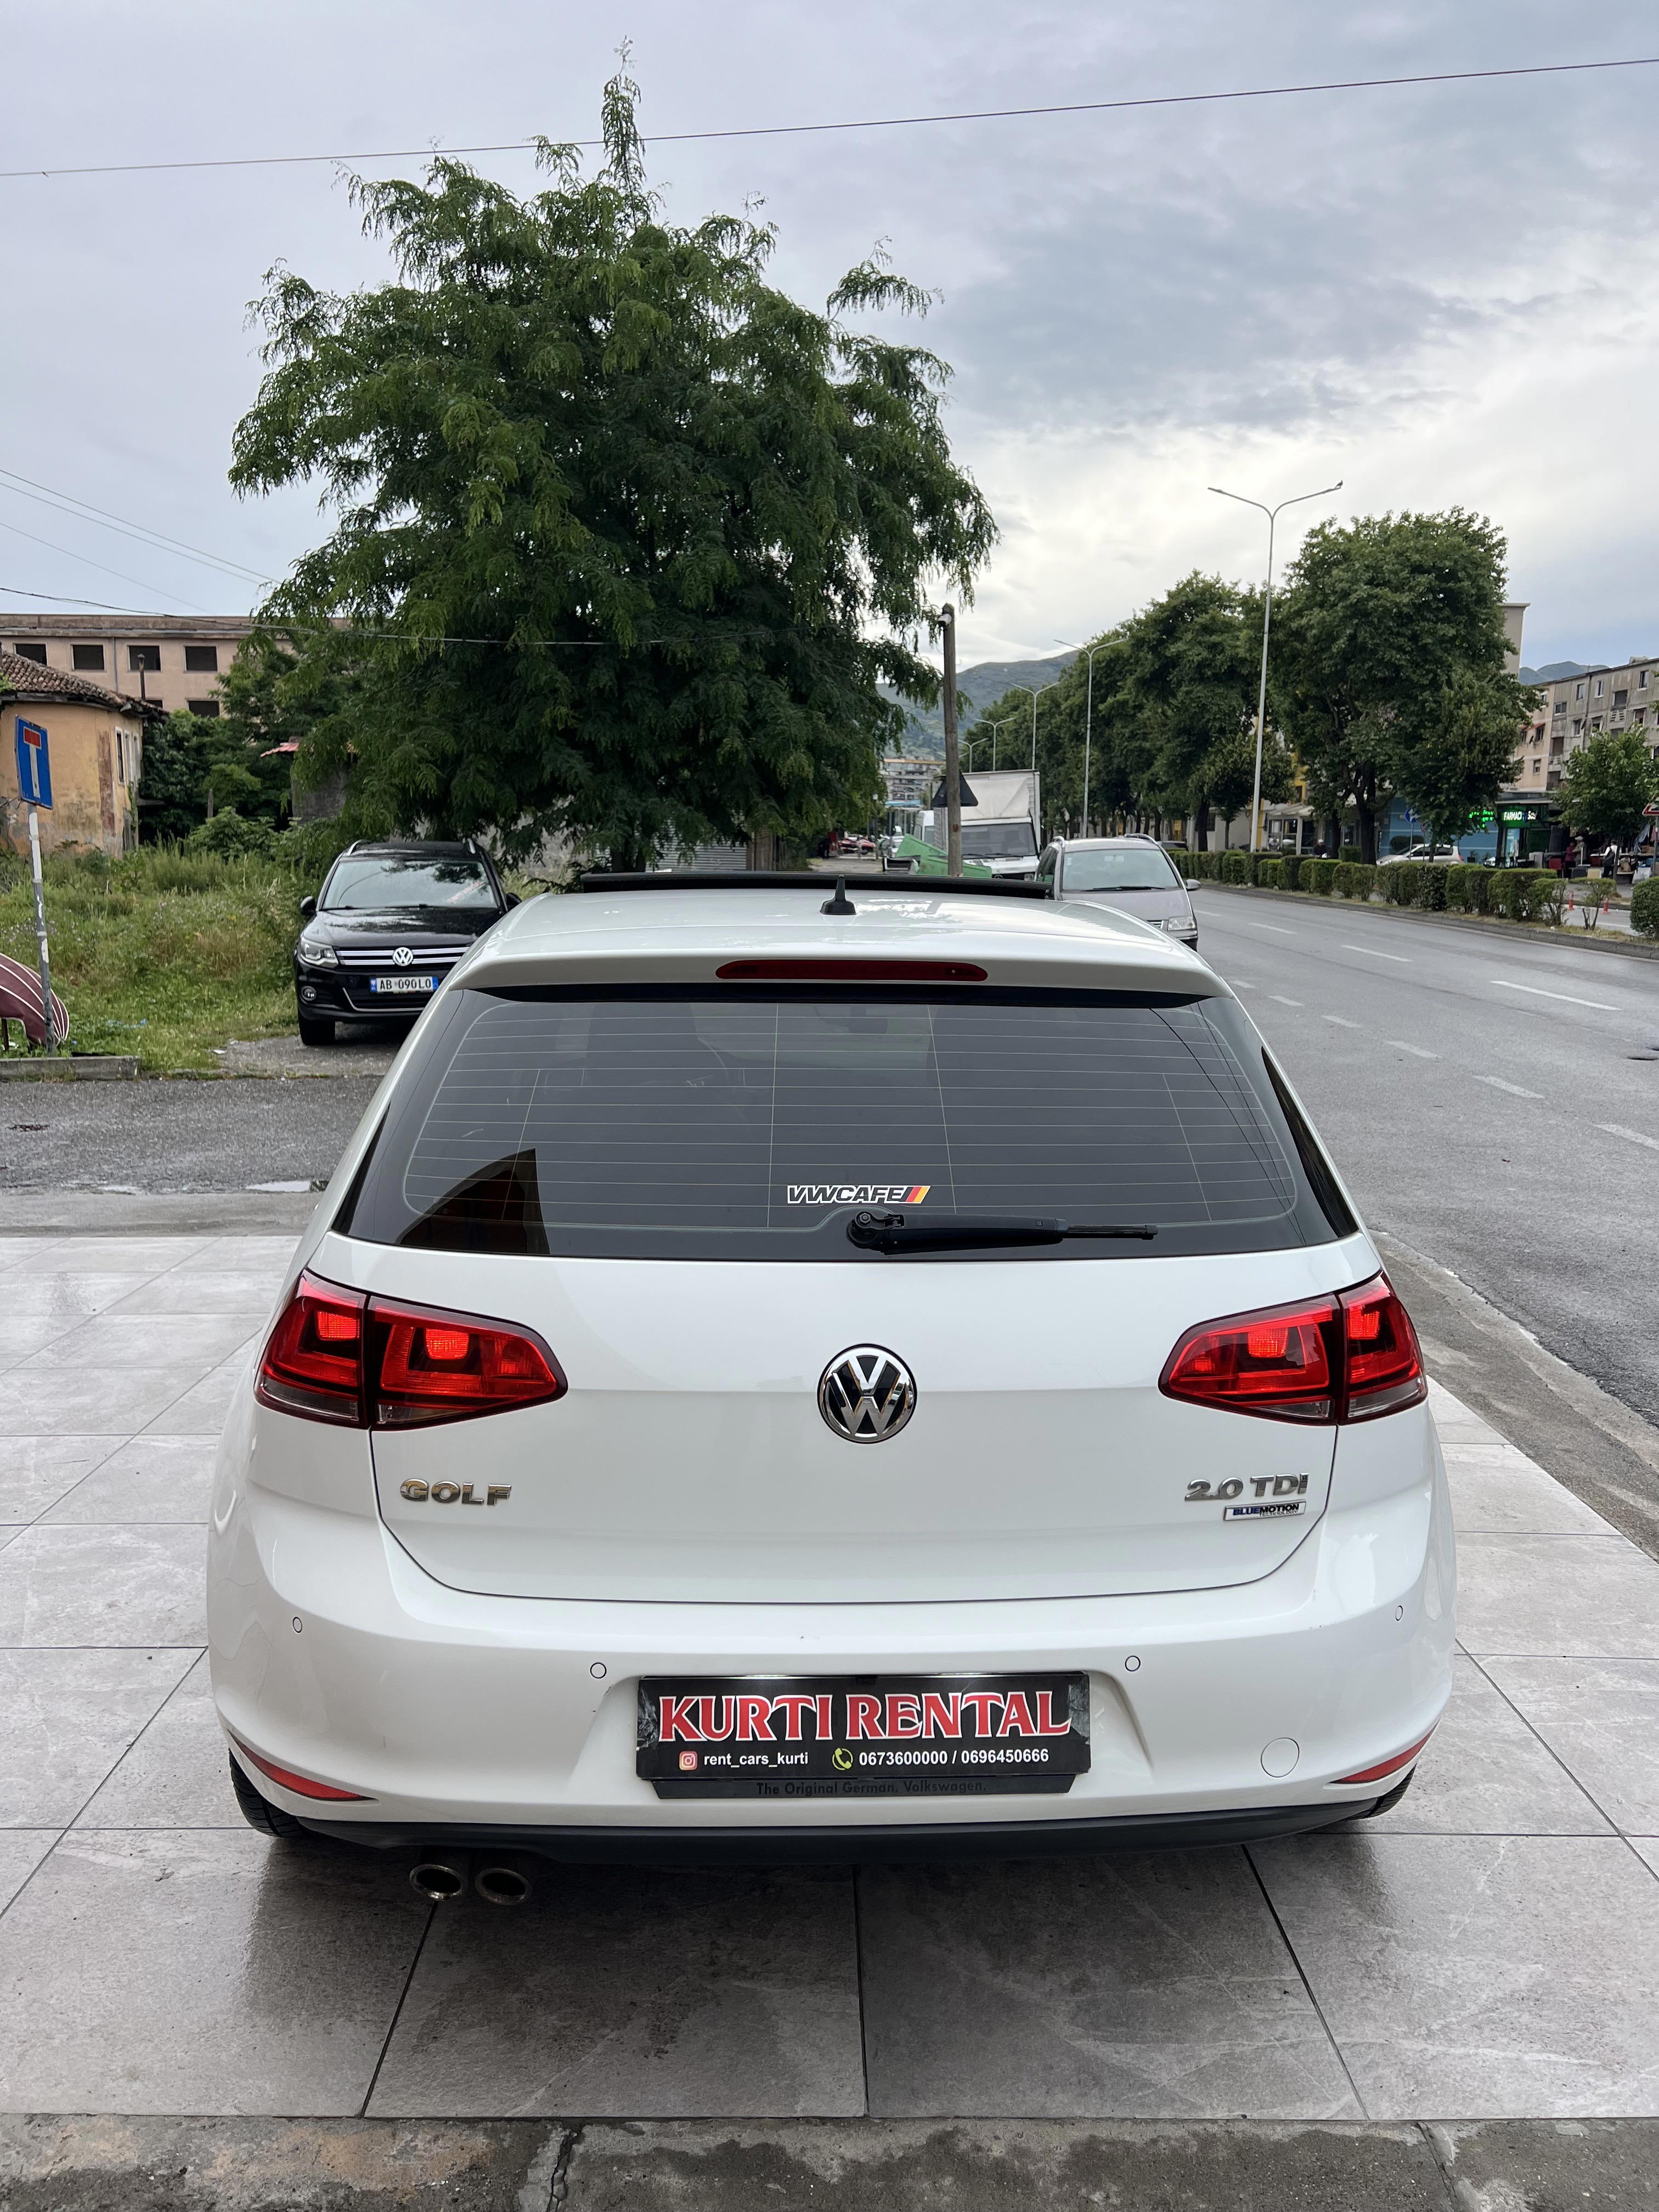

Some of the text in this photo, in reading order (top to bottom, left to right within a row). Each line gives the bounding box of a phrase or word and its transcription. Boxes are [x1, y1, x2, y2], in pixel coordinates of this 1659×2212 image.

[380, 980, 392, 990] AB
[788, 1185, 905, 1204] VWCAFE
[400, 1478, 512, 1506] GOLF
[1184, 1472, 1309, 1501] 2.0 TDI
[1233, 1503, 1299, 1516] BLUEMOTION
[659, 1691, 1071, 1741] KURTI RENTAL
[704, 1752, 808, 1768] rent_cars_kurti
[859, 1751, 948, 1765] 0673600000
[961, 1748, 1049, 1764] 0696450666
[757, 1782, 779, 1795] The
[785, 1781, 838, 1796] Original
[904, 1779, 986, 1793] Volkswagen.
